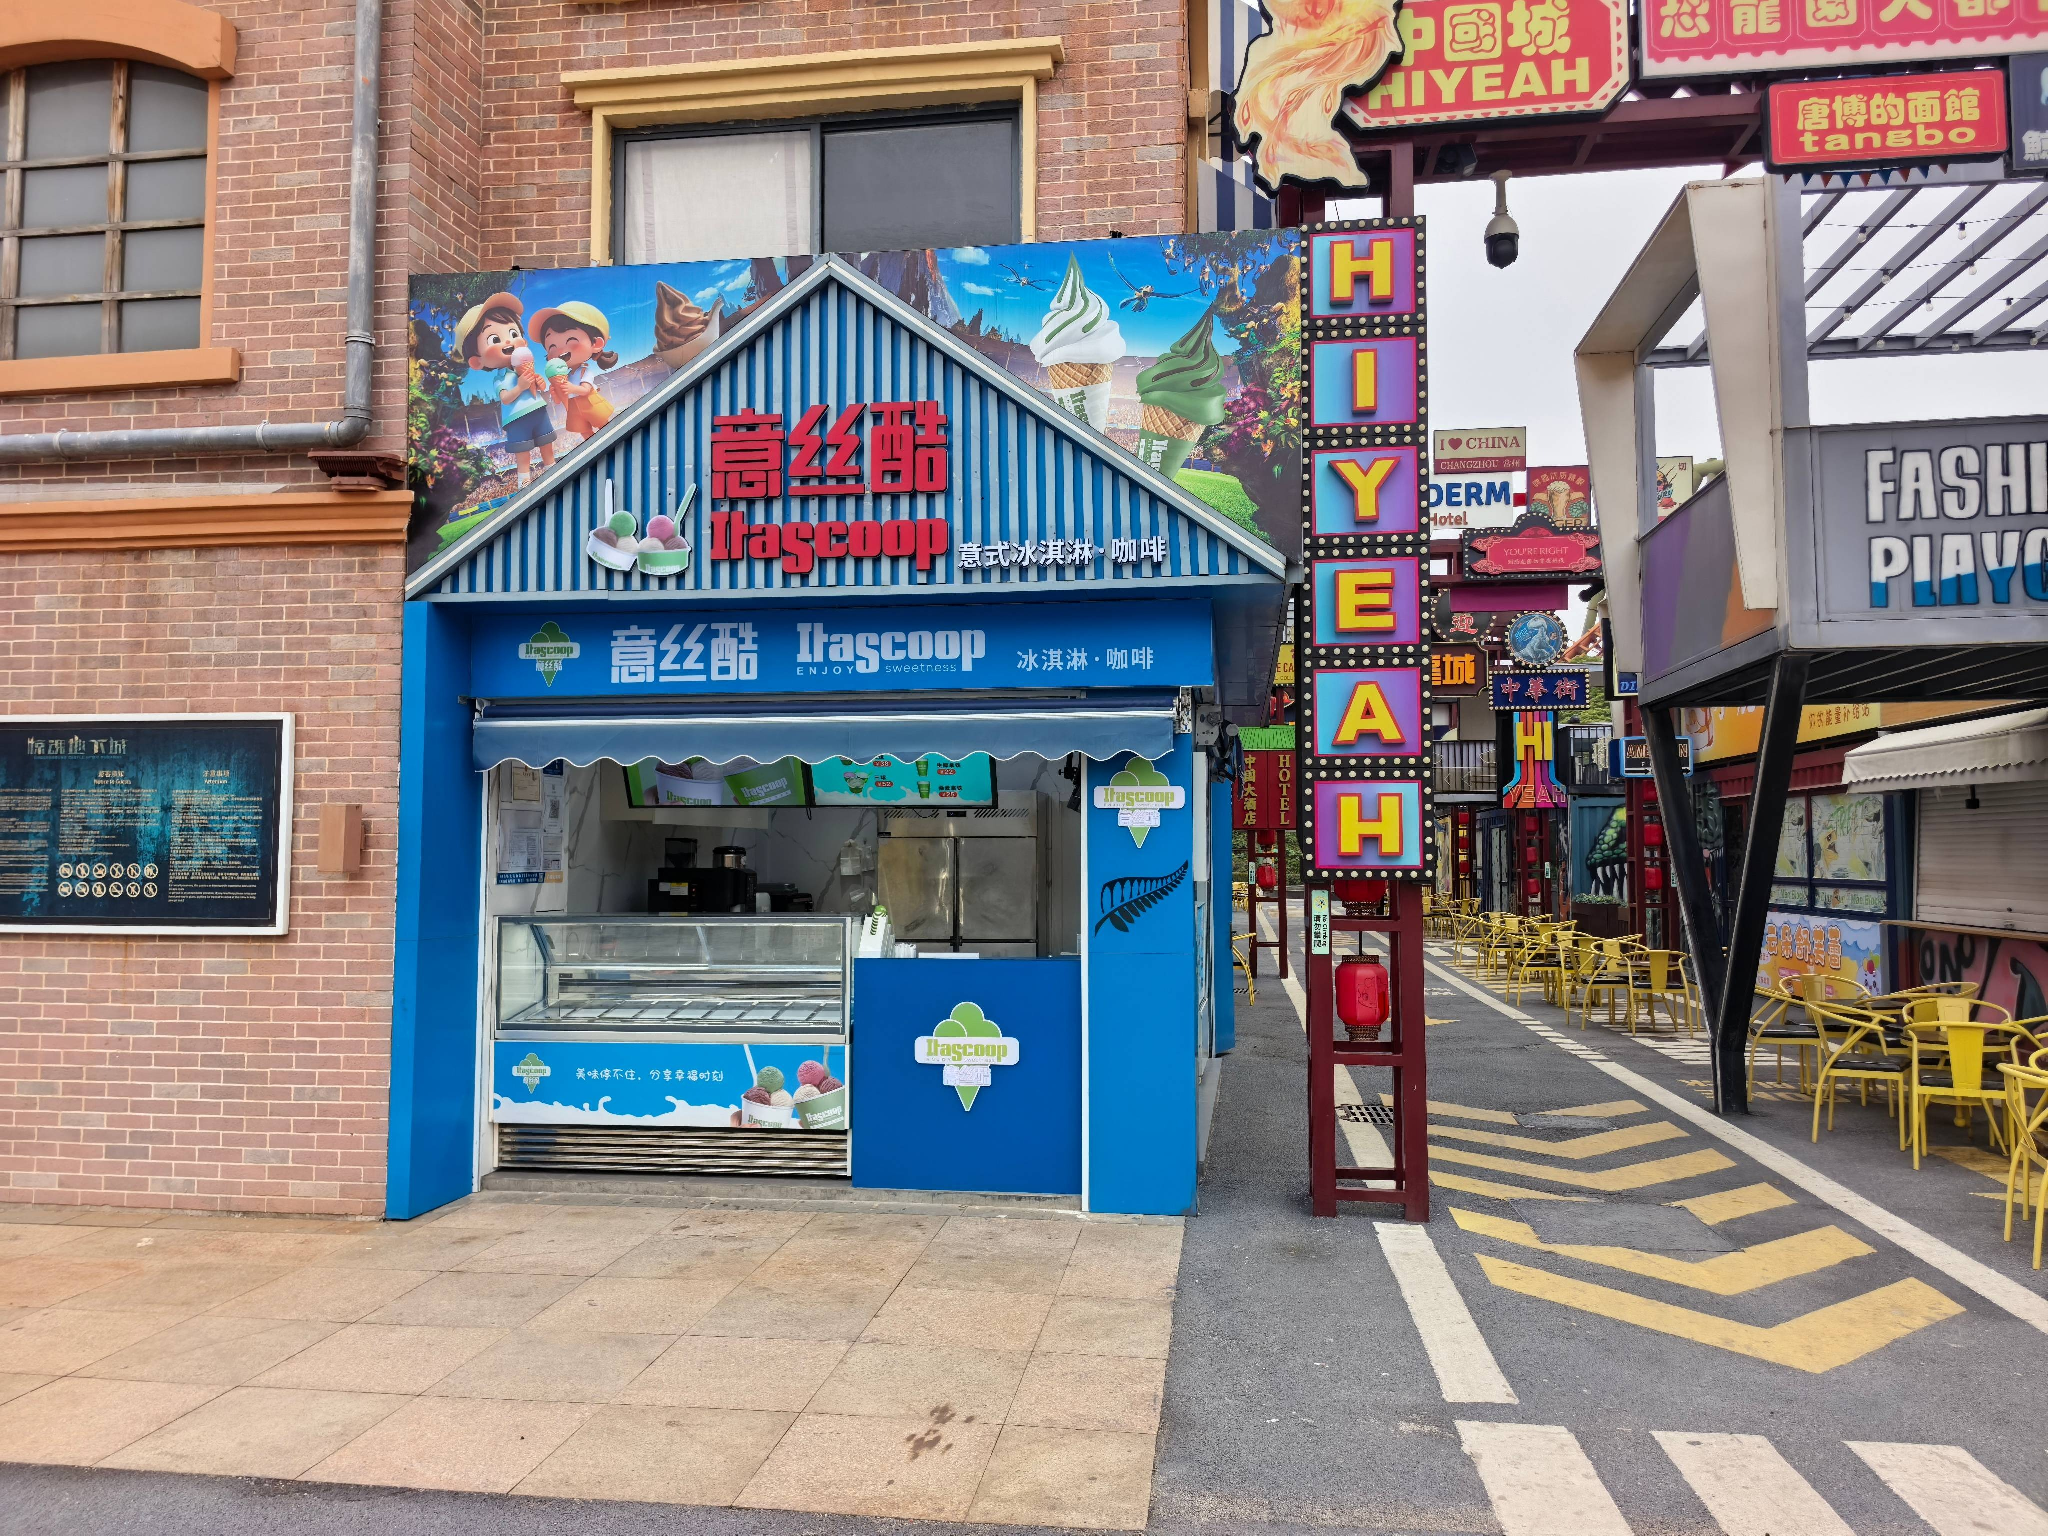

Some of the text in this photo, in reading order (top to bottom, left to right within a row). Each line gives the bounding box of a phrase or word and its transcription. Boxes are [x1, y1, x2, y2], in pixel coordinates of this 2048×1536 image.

[1398, 0, 1571, 66] 中國城
[1368, 57, 1590, 109] HIYEAH
[1797, 87, 1981, 131] 唐博的面館
[1799, 126, 1977, 153] tangbo
[710, 400, 950, 500] 意丝酷
[1440, 459, 1499, 470] CHANGZHOU
[1465, 435, 1521, 451] CHINA
[710, 511, 950, 575] Itascoop
[610, 621, 759, 684] 意丝酷
[796, 622, 986, 674] Itascoop
[797, 662, 957, 676] ENJOY sweetness
[1500, 677, 1580, 704] 中華街
[1516, 722, 1554, 761] HI
[1278, 754, 1291, 826] HOTEL
[1509, 785, 1567, 803] YEAH
